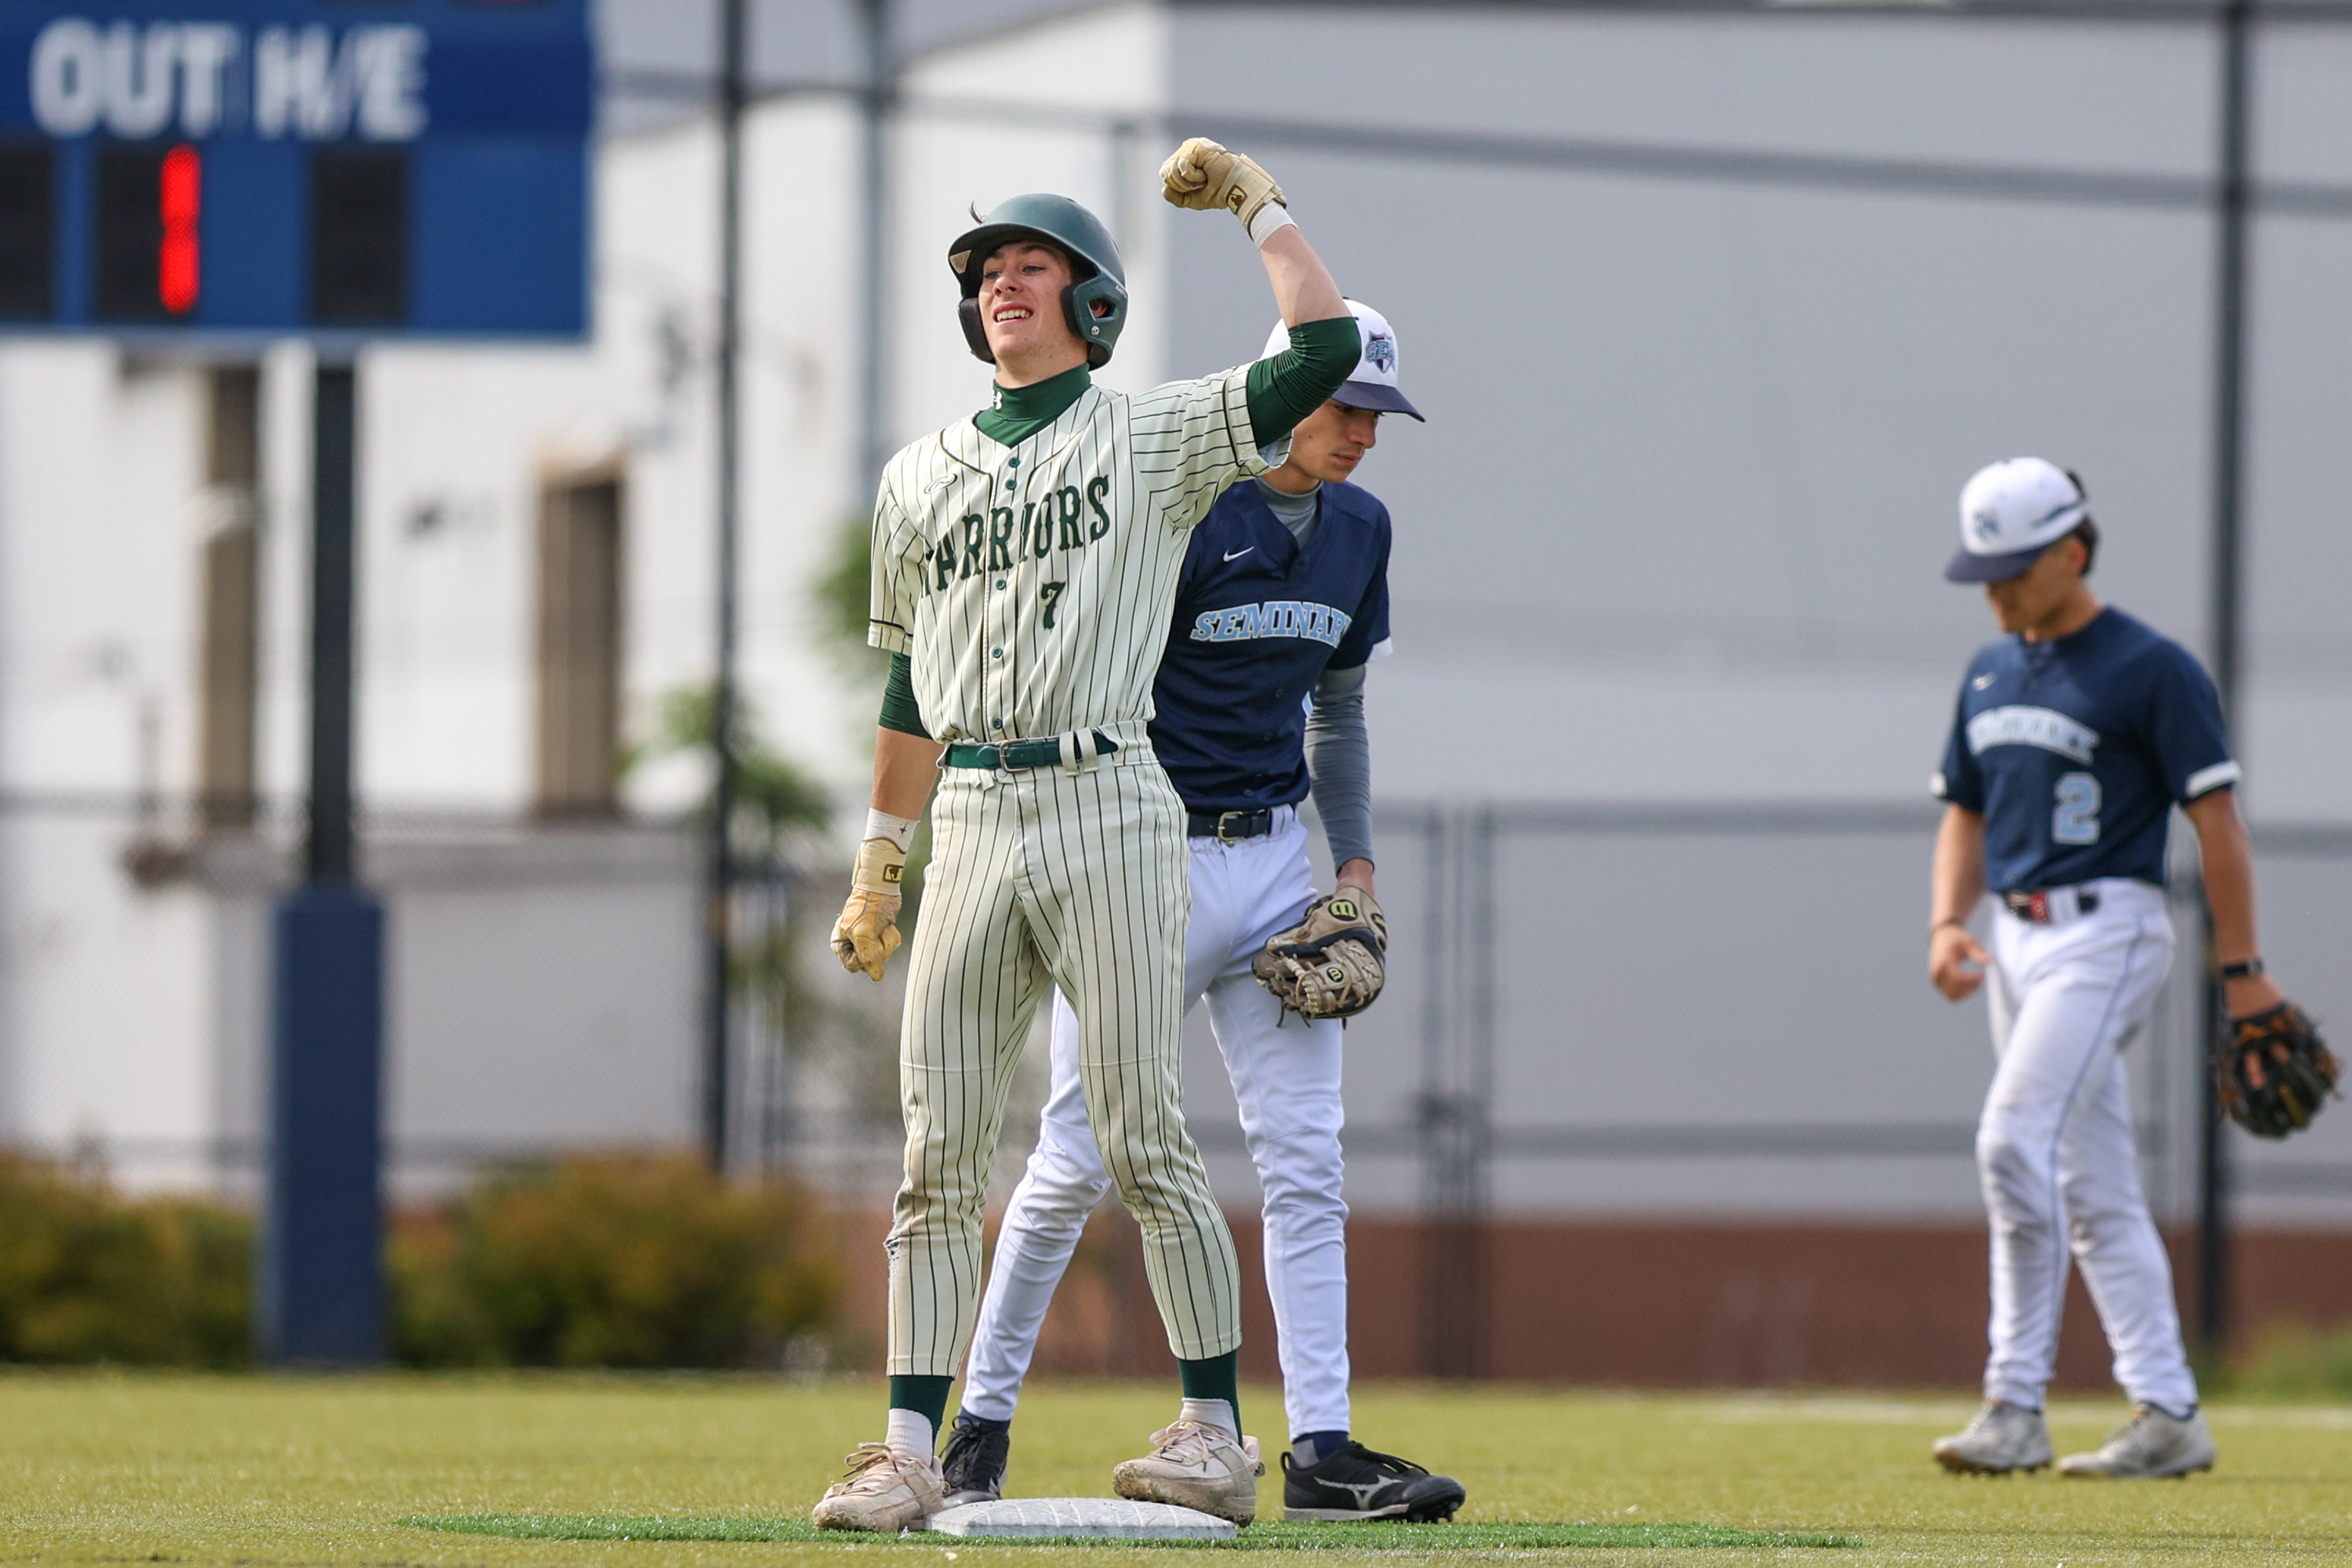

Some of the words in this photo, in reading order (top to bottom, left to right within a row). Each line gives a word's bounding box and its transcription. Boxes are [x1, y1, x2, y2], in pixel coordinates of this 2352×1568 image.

[31, 17, 235, 139] OUT
[253, 24, 428, 141] H/E
[159, 143, 201, 313] 1
[924, 474, 1109, 597] ARRIORS
[1041, 581, 1066, 630] 7
[2052, 771, 2102, 844] 2
